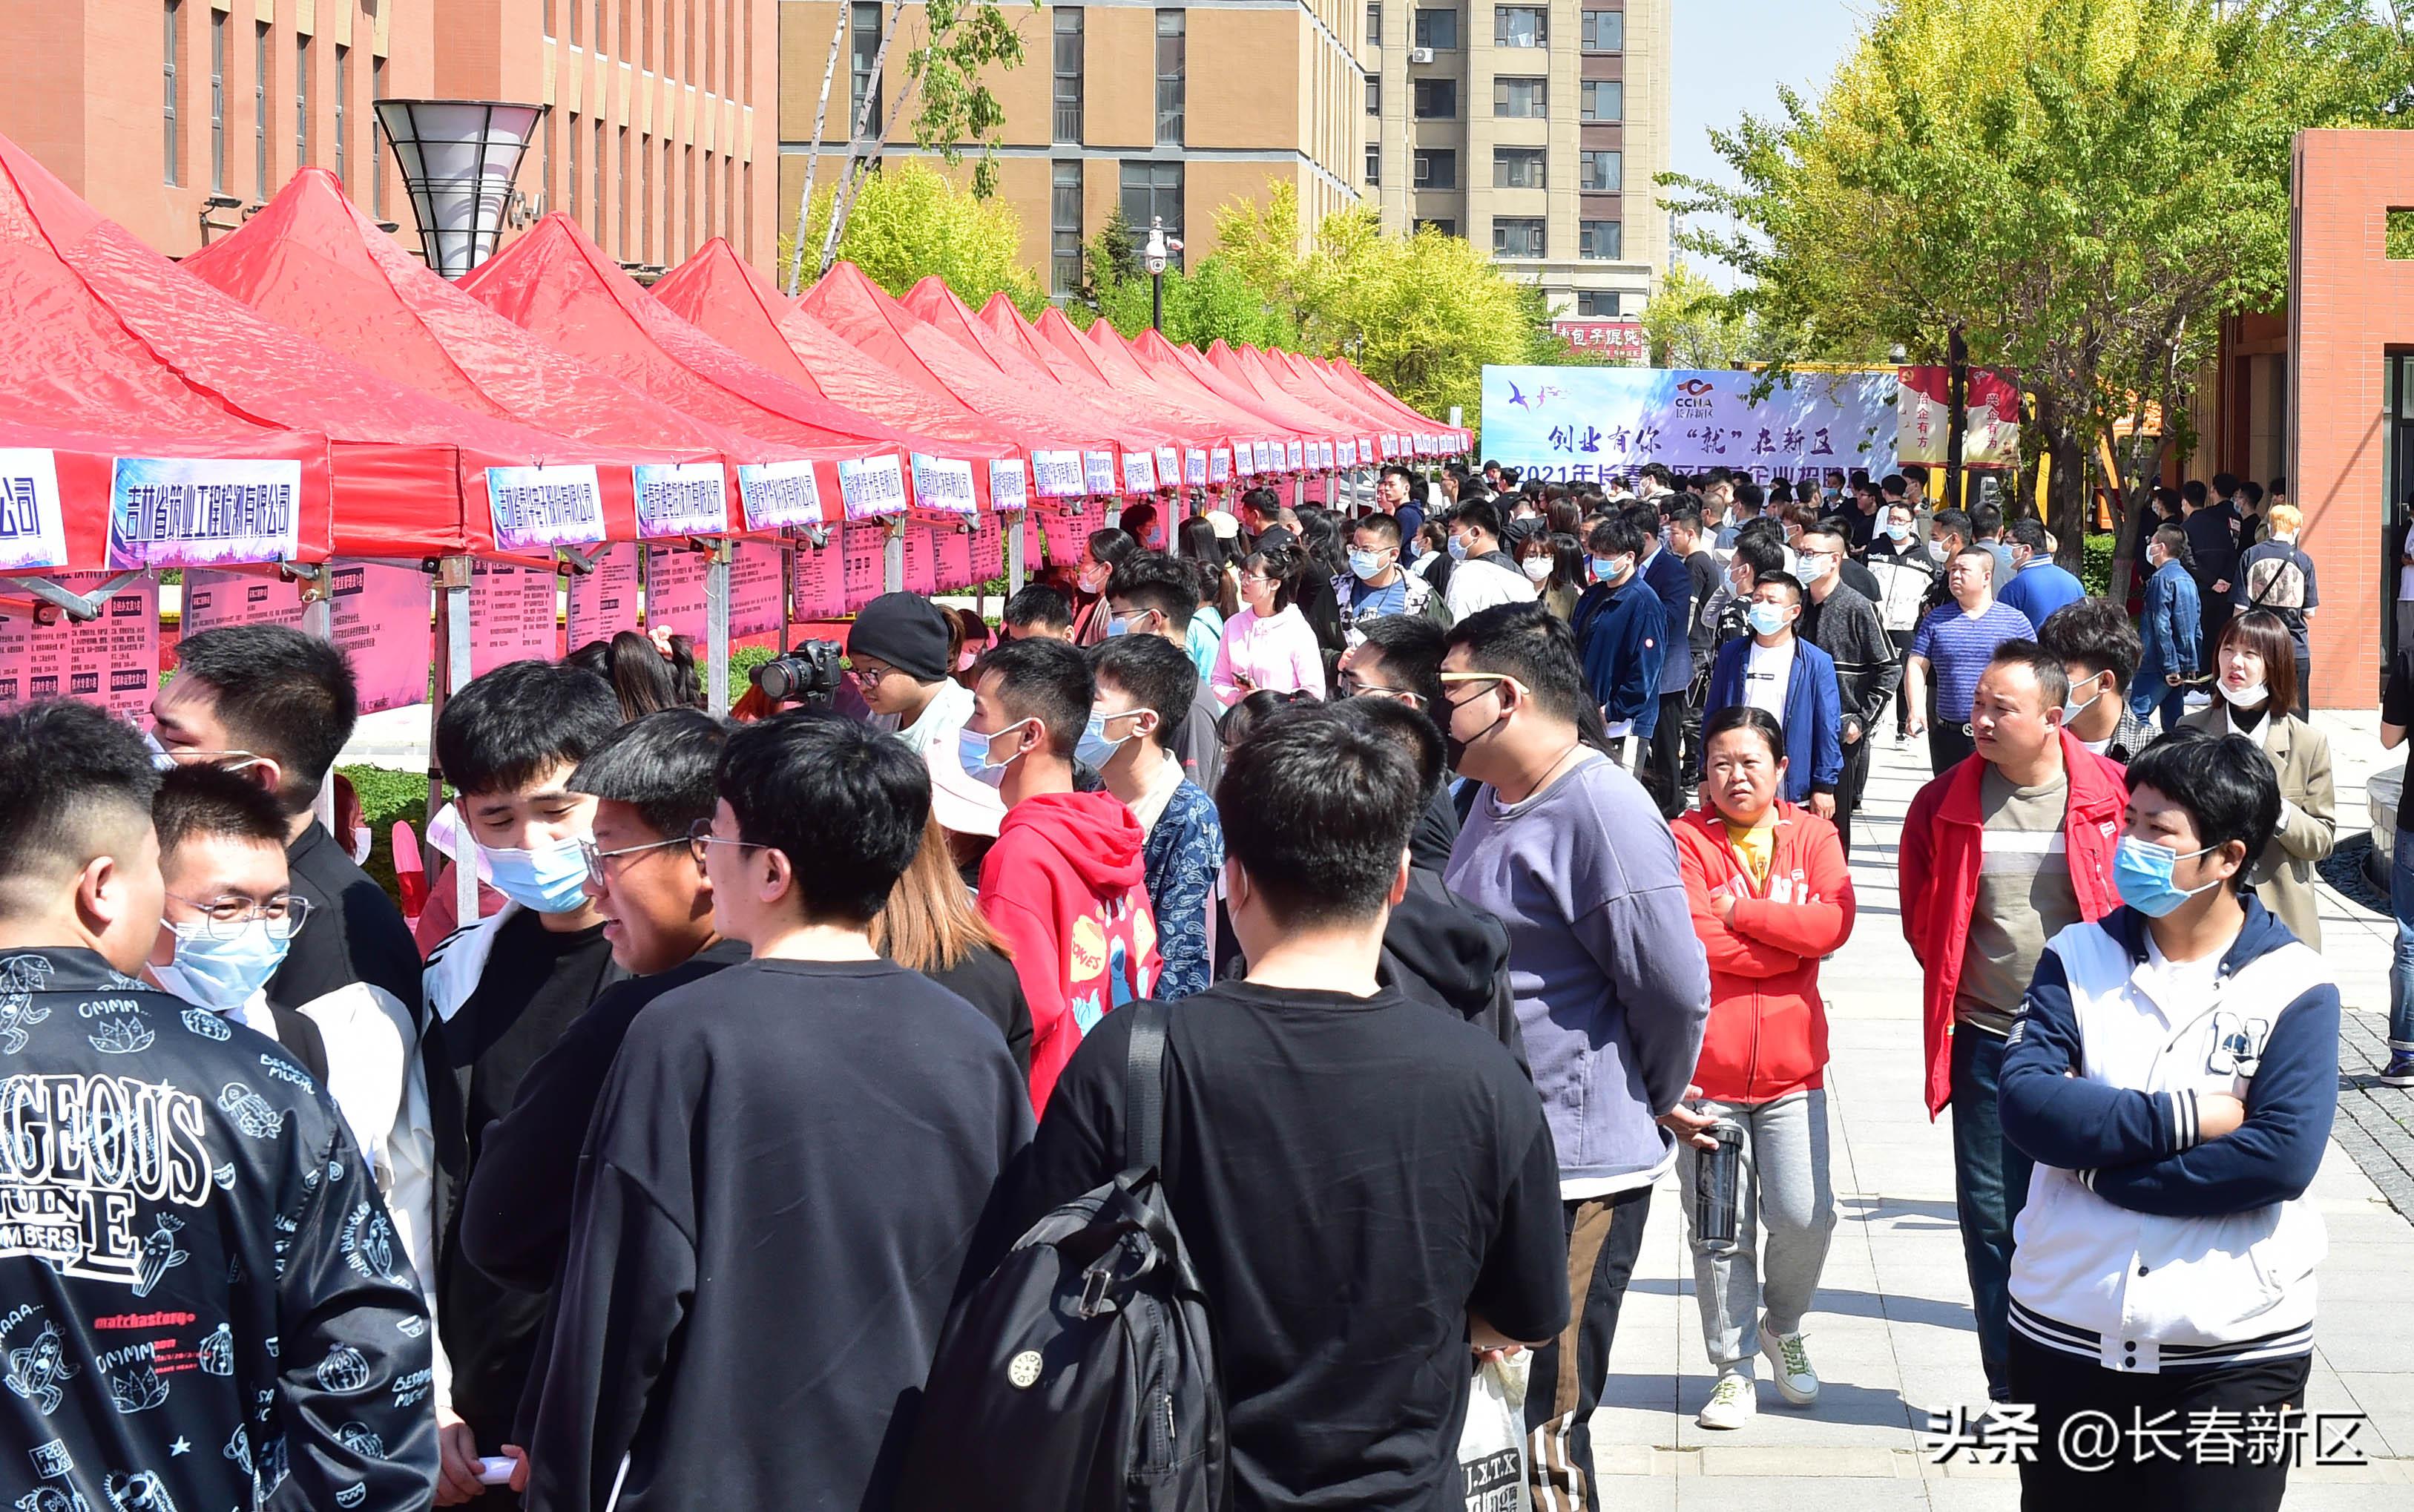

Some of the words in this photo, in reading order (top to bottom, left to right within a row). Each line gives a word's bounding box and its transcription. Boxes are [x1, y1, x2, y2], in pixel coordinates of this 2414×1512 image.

[1676, 408, 1714, 419] 长春新区
[1986, 392, 2000, 449] 兴企有为
[1548, 424, 1662, 454] 创业有你
[126, 484, 290, 540] 吉林省筑业工程检测有限公司
[1073, 940, 1102, 970] OKIES
[0, 1074, 212, 1207] GEOUS
